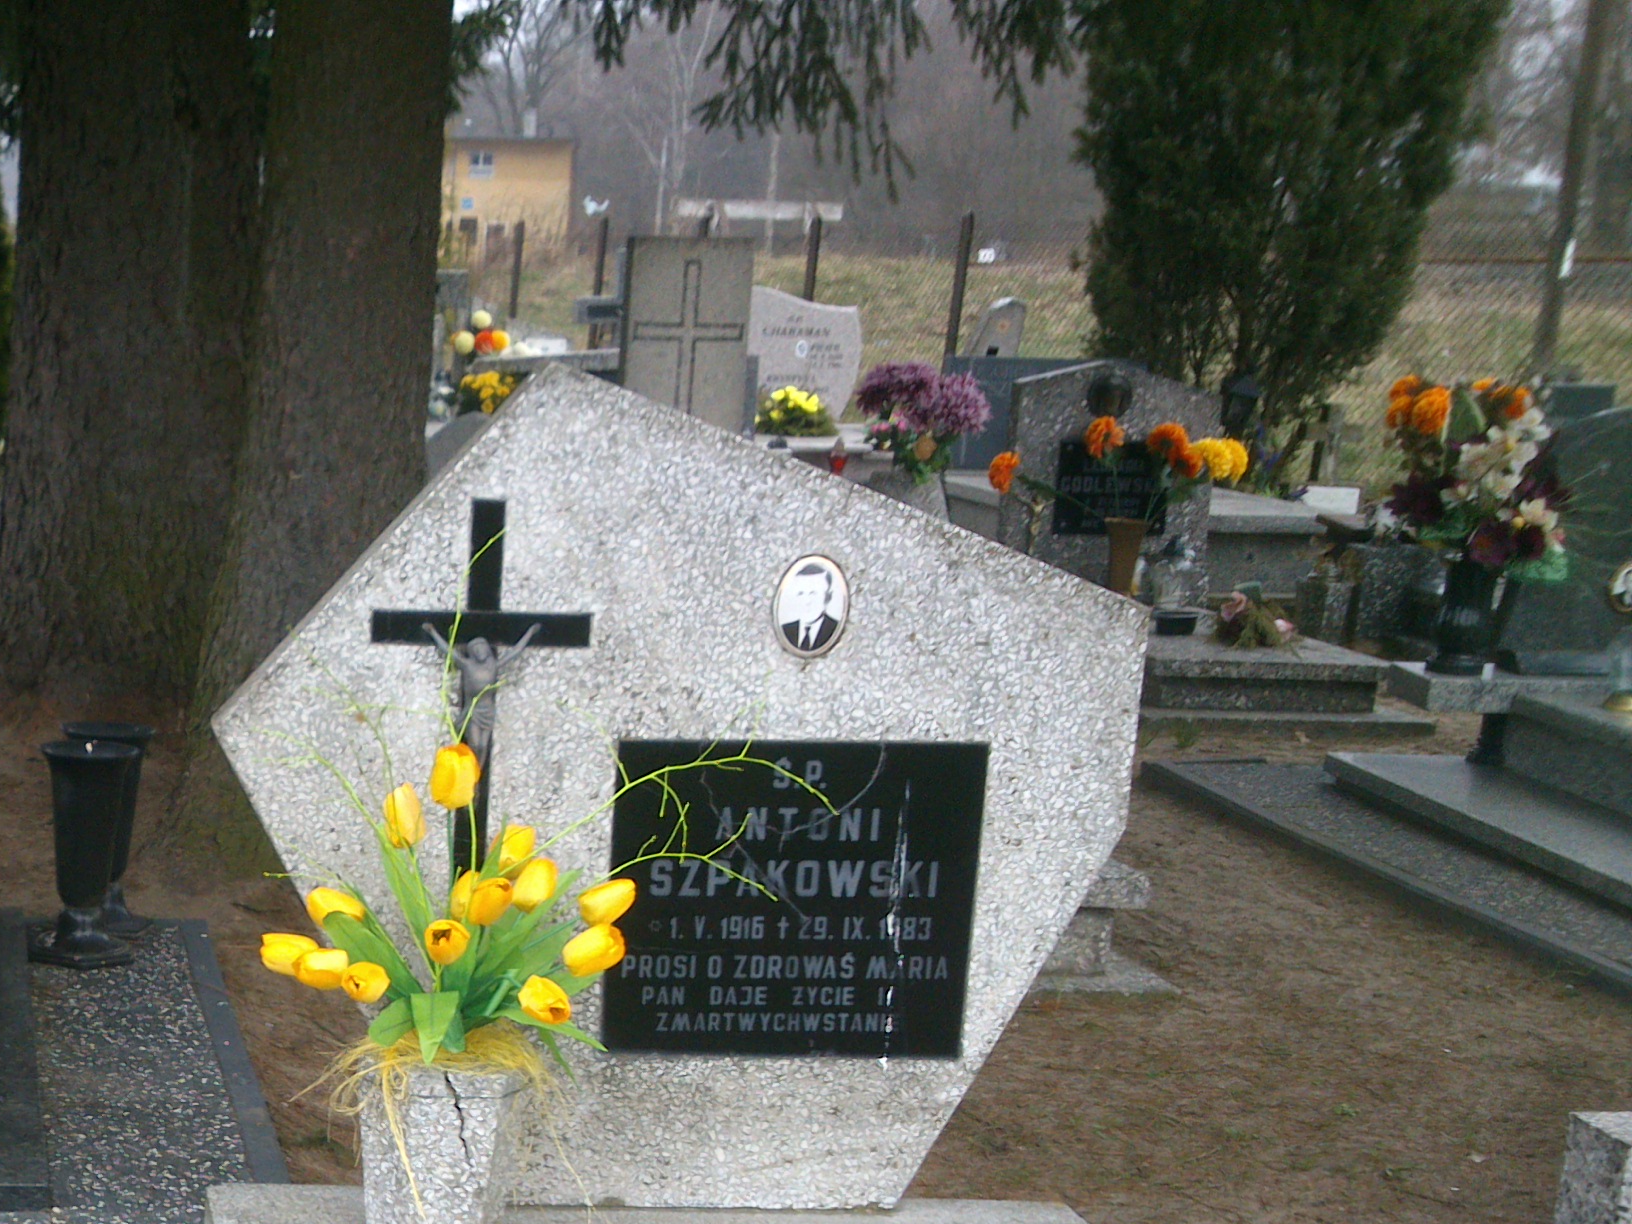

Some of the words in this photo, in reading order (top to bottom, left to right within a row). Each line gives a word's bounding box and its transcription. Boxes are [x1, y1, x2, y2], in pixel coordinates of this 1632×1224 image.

[714, 807, 881, 842] ANTONI
[649, 858, 940, 898] SZPAKOWSKI
[621, 955, 697, 980] PROSI
[707, 955, 723, 980] O
[732, 952, 856, 980] ZDROWAŚ
[641, 985, 686, 1006] PAN
[709, 986, 768, 1006] DAJE
